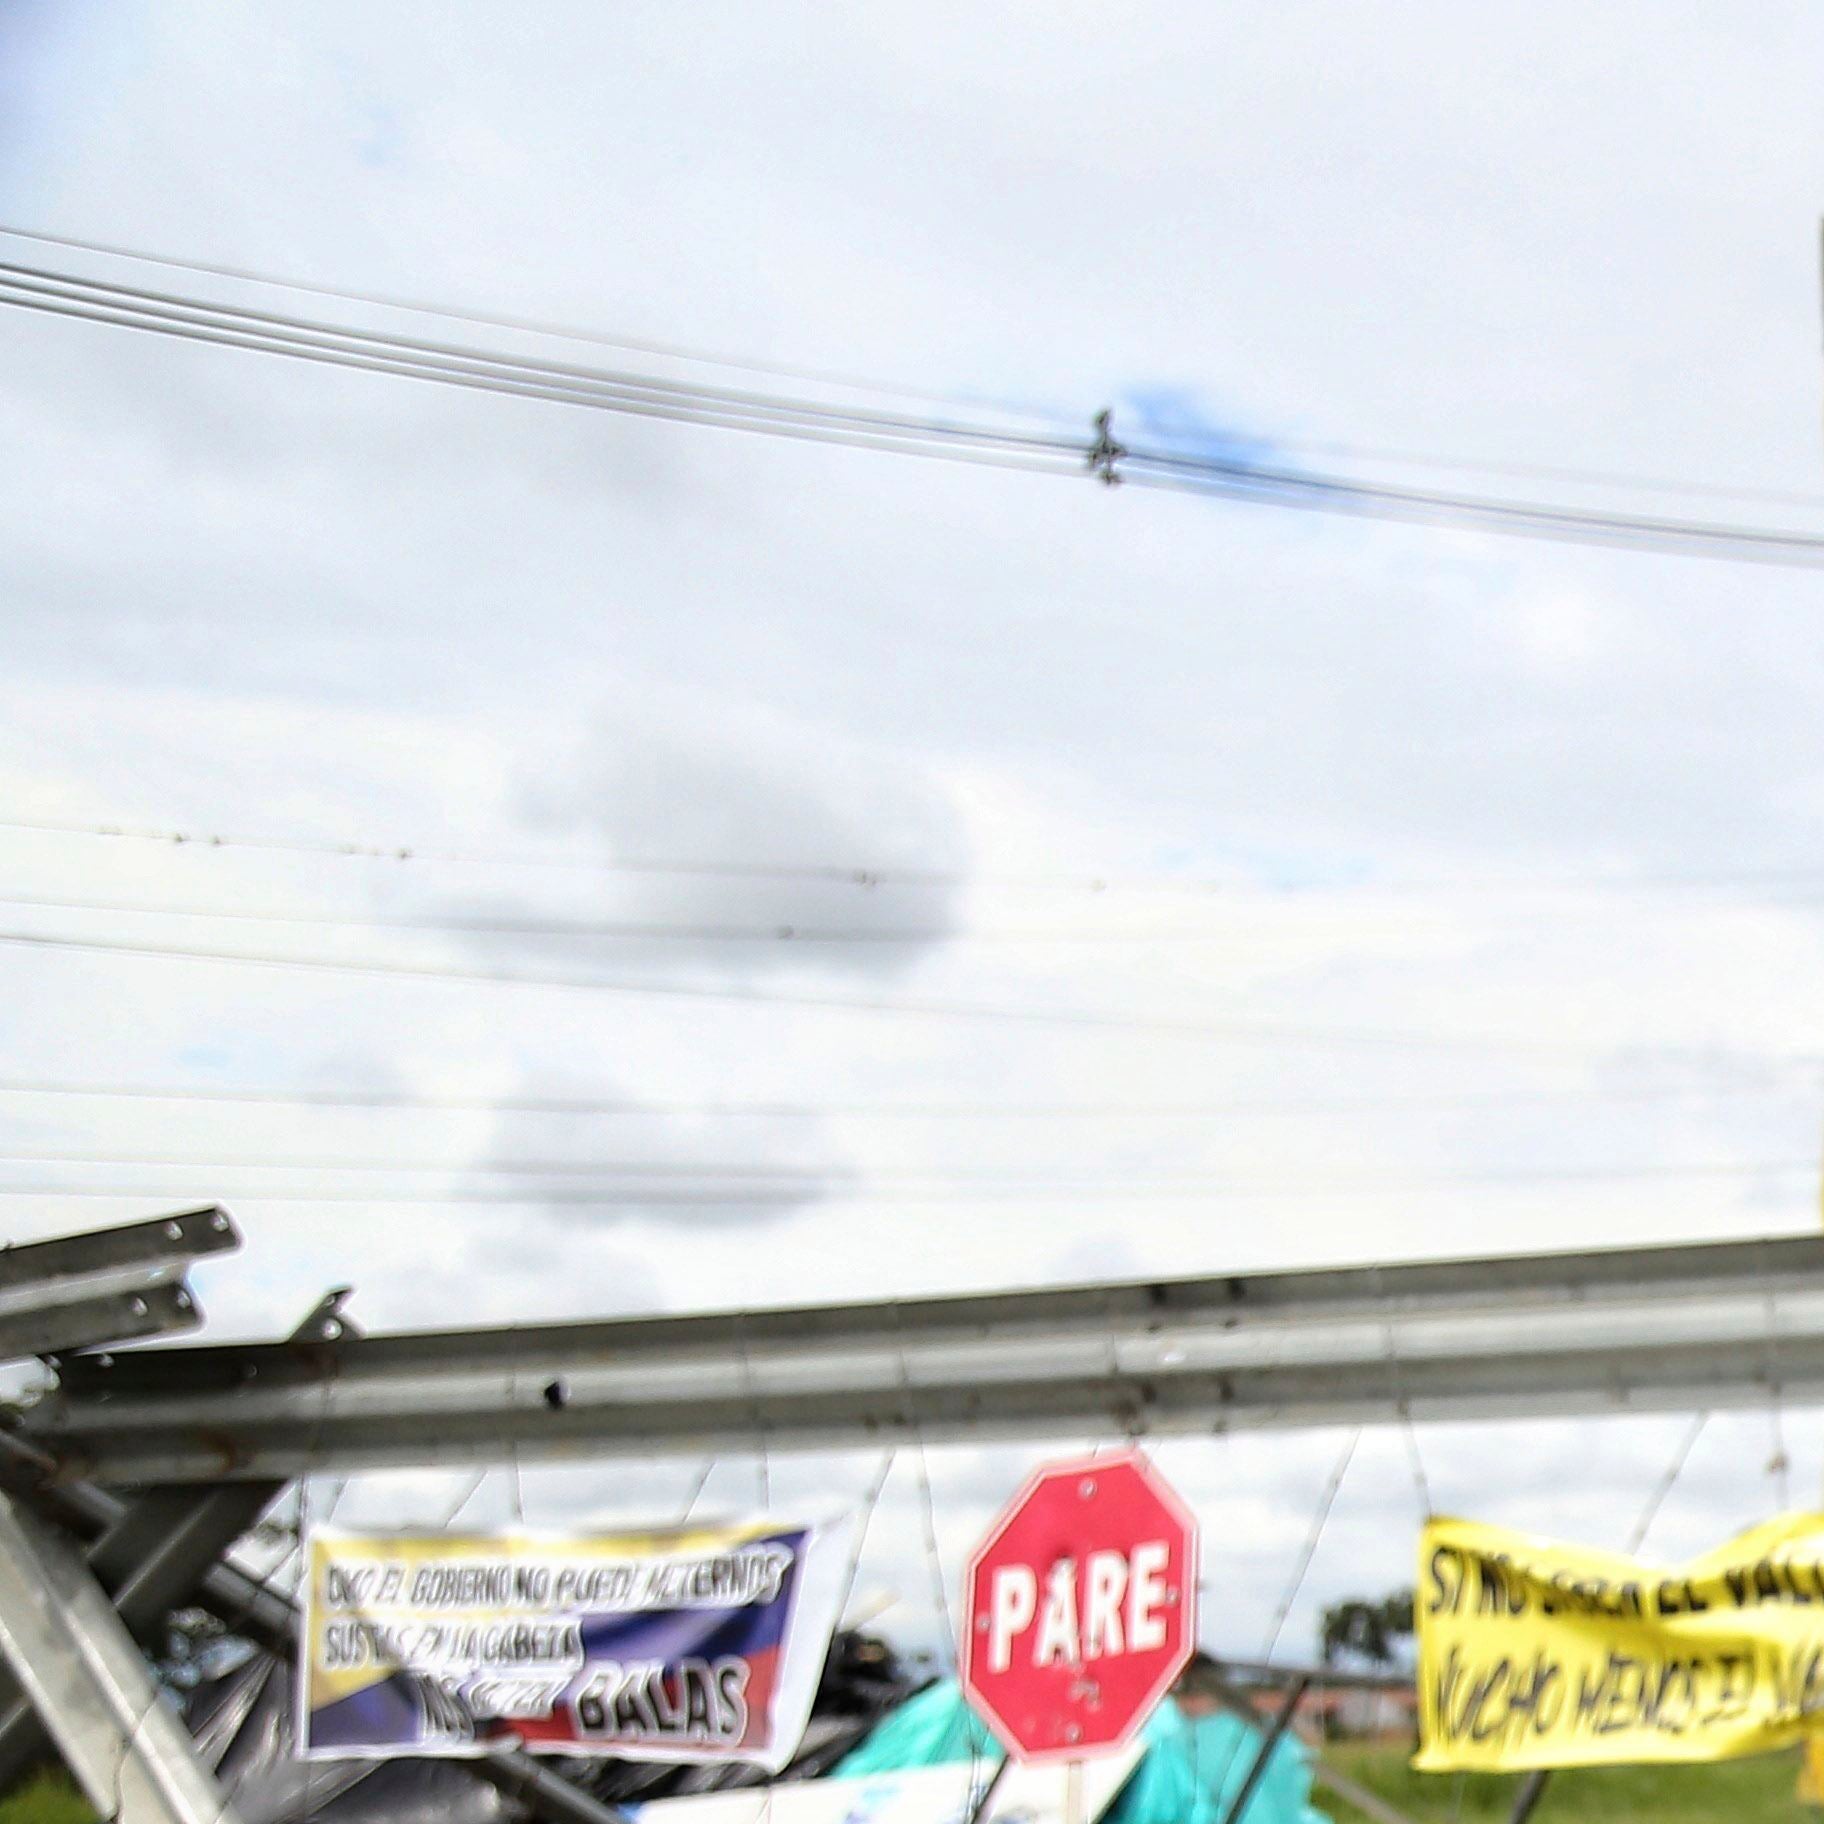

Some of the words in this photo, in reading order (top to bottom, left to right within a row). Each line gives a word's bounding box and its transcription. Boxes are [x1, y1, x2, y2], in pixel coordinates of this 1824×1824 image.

[411, 1565, 511, 1605] GOBIERNO
[516, 1565, 549, 1603] NO
[986, 1541, 1170, 1673] PARE
[579, 1663, 743, 1733] BALAS
